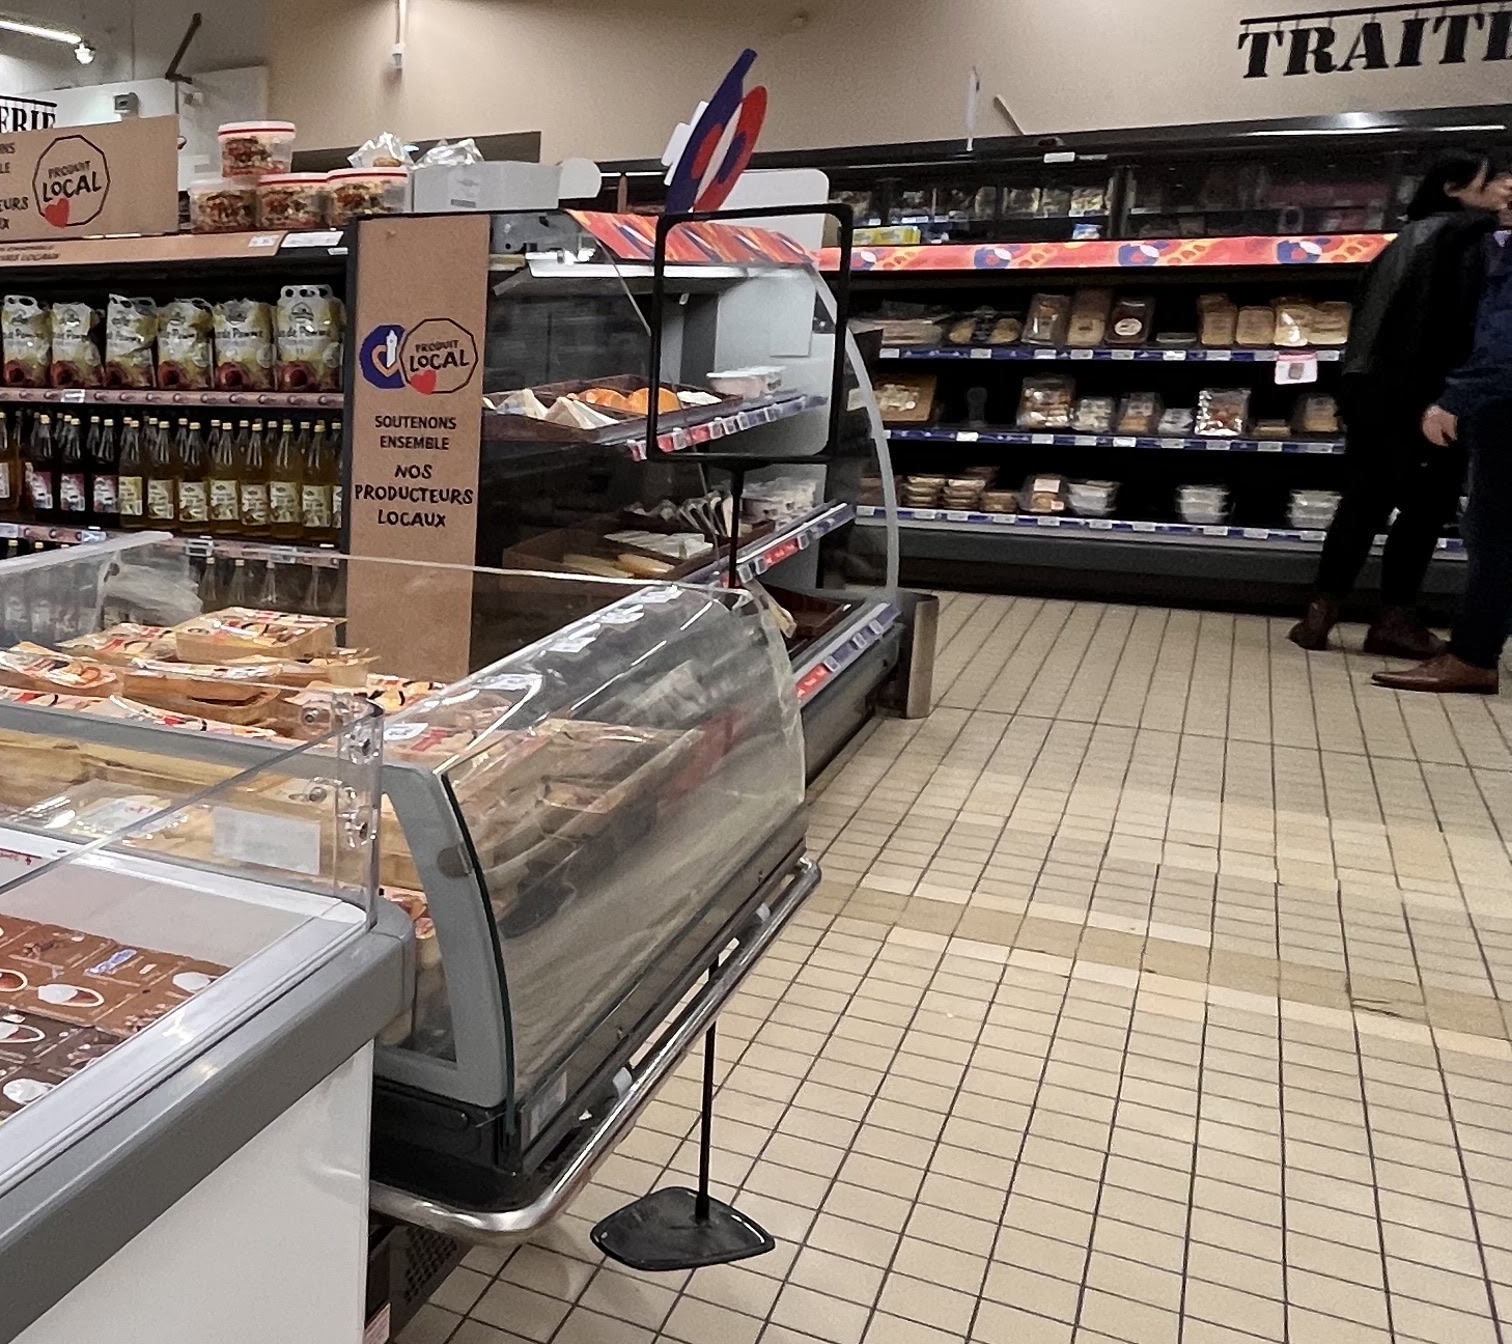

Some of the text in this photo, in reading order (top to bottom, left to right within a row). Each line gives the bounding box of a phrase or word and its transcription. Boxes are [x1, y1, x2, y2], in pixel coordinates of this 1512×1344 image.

[48, 160, 91, 179] PRODUIT
[42, 171, 102, 202] LOCAL
[415, 340, 459, 354] PRODUIT
[409, 349, 470, 372] LOCAL
[375, 415, 457, 430] SOUTENONS
[380, 436, 450, 451] ENSEMBLE
[394, 464, 433, 479] NOS
[355, 484, 473, 505] PRODUCTEURS
[378, 509, 446, 528] LOCAUX
